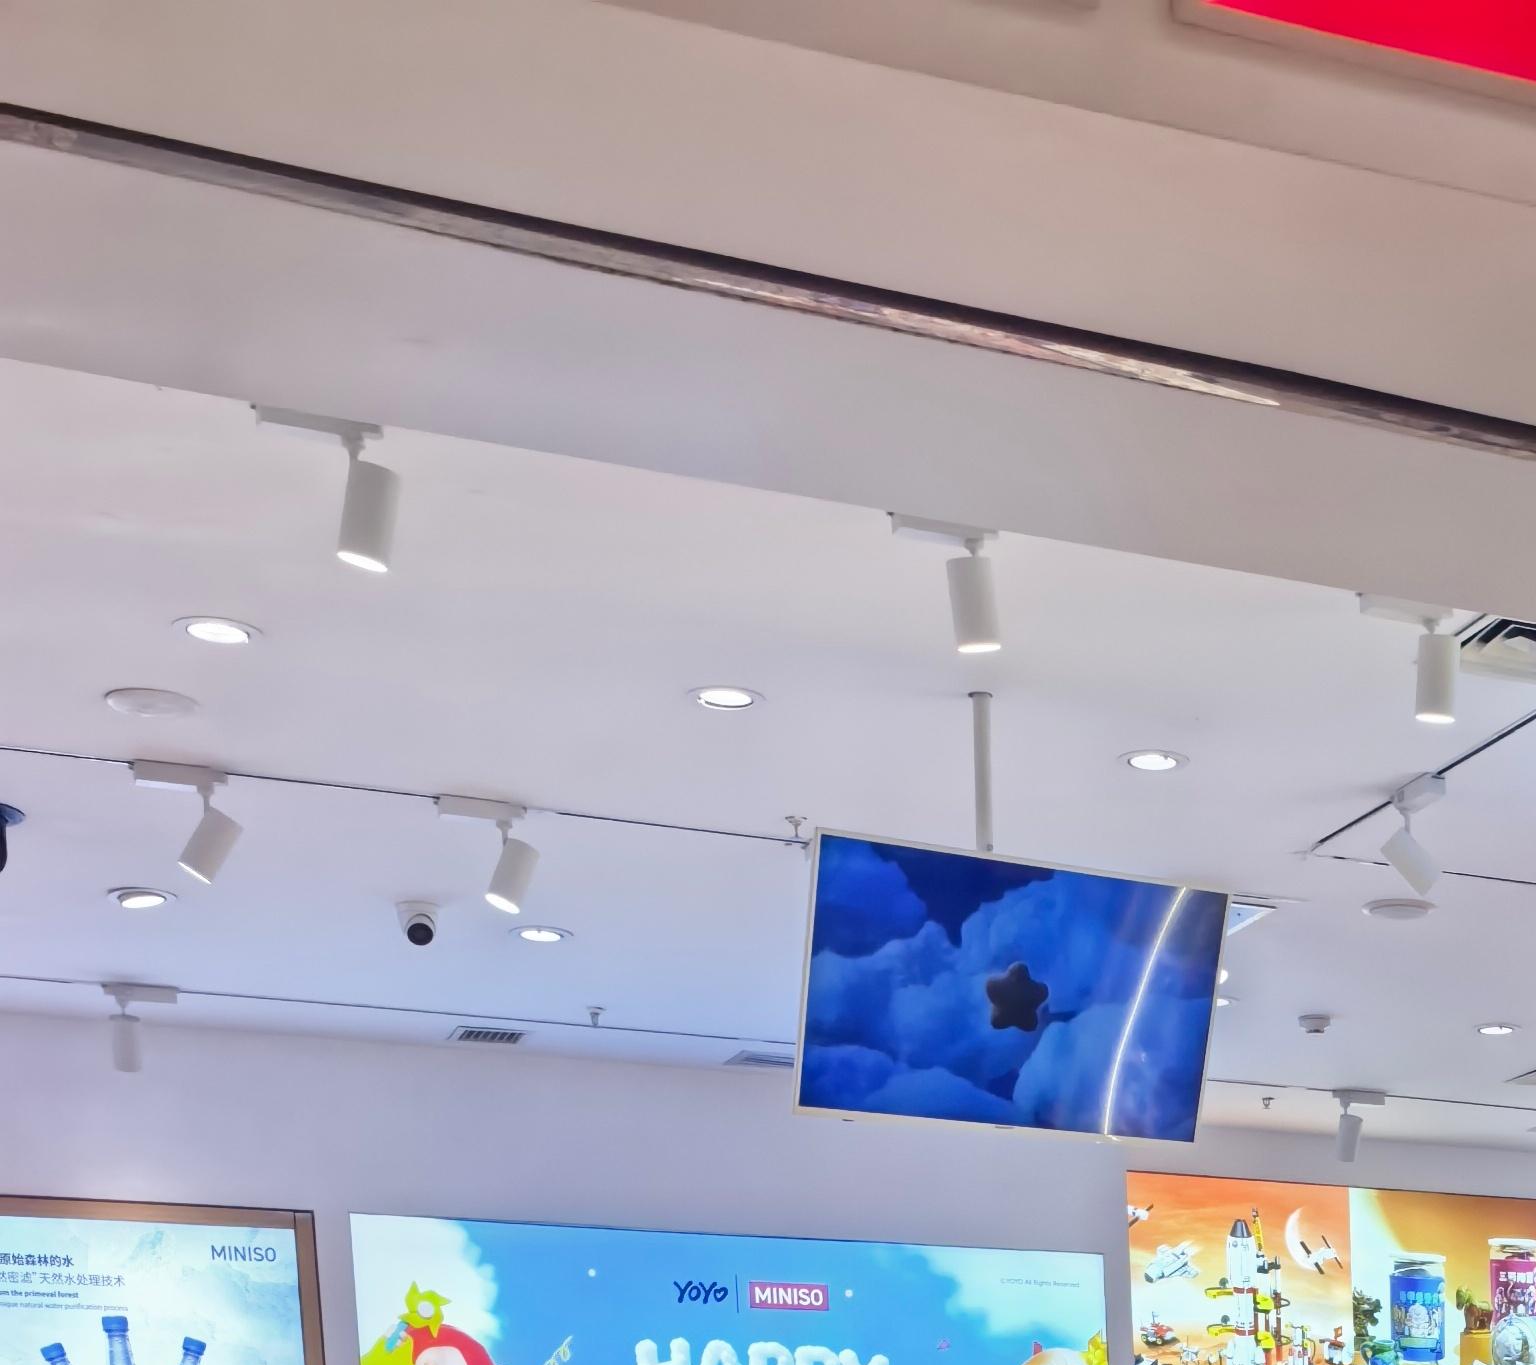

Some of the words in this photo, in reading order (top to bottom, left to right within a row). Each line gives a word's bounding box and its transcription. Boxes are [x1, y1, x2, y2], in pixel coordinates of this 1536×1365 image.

[210, 1244, 277, 1262] MINISO
[673, 1280, 729, 1304] YOYO
[754, 1286, 824, 1306] MINISO
